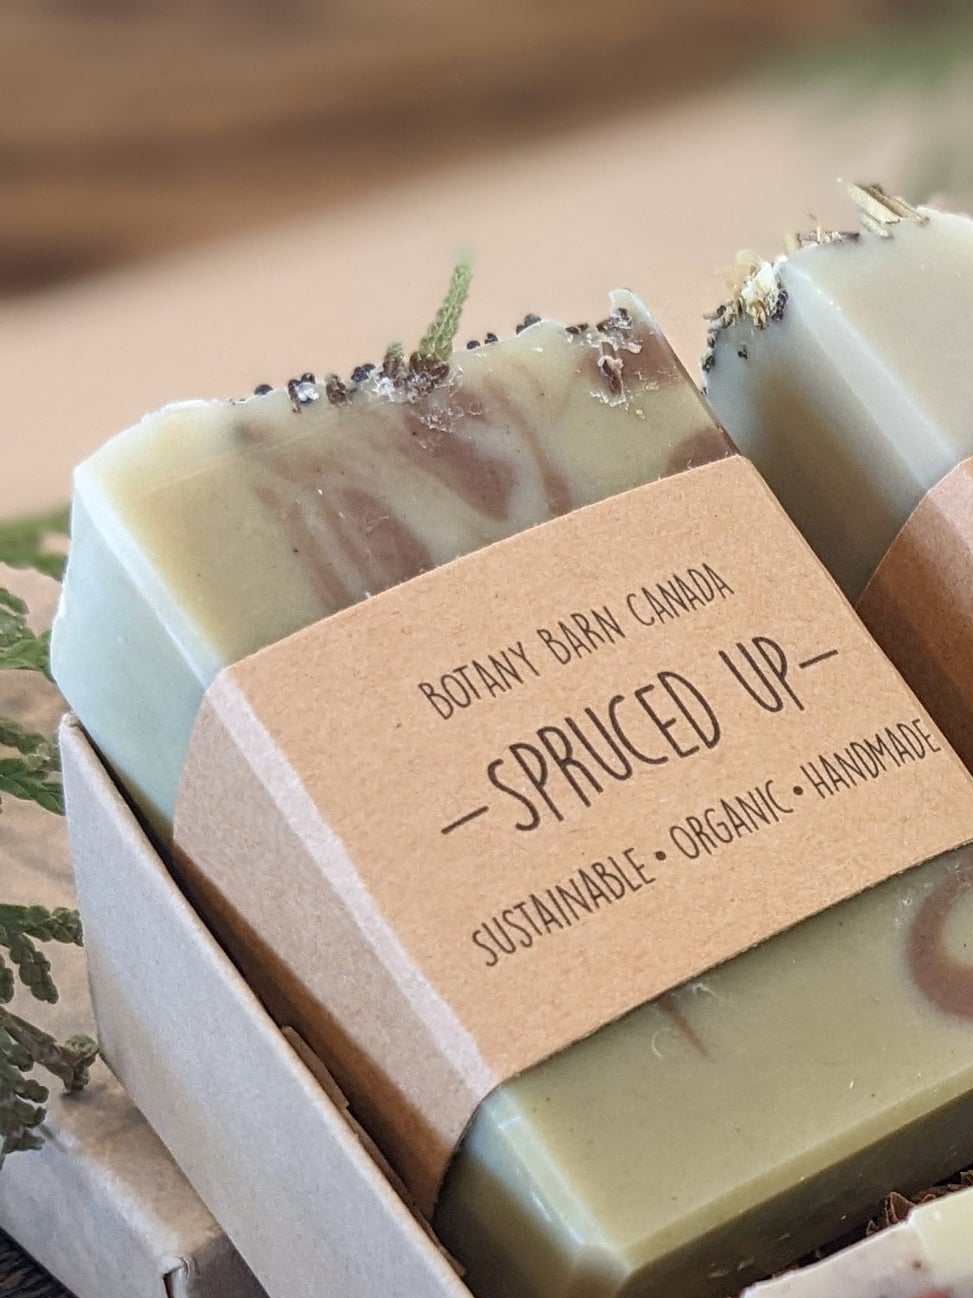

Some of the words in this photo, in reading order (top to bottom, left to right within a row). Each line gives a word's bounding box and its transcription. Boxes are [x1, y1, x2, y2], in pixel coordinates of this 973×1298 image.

[418, 641, 540, 720] BOTANY
[537, 606, 625, 665] BARN
[627, 563, 734, 626] CANADA
[472, 848, 656, 966] SUSTAINABLE
[670, 780, 793, 859] ORGANIC
[802, 719, 941, 799] HANDMADE
